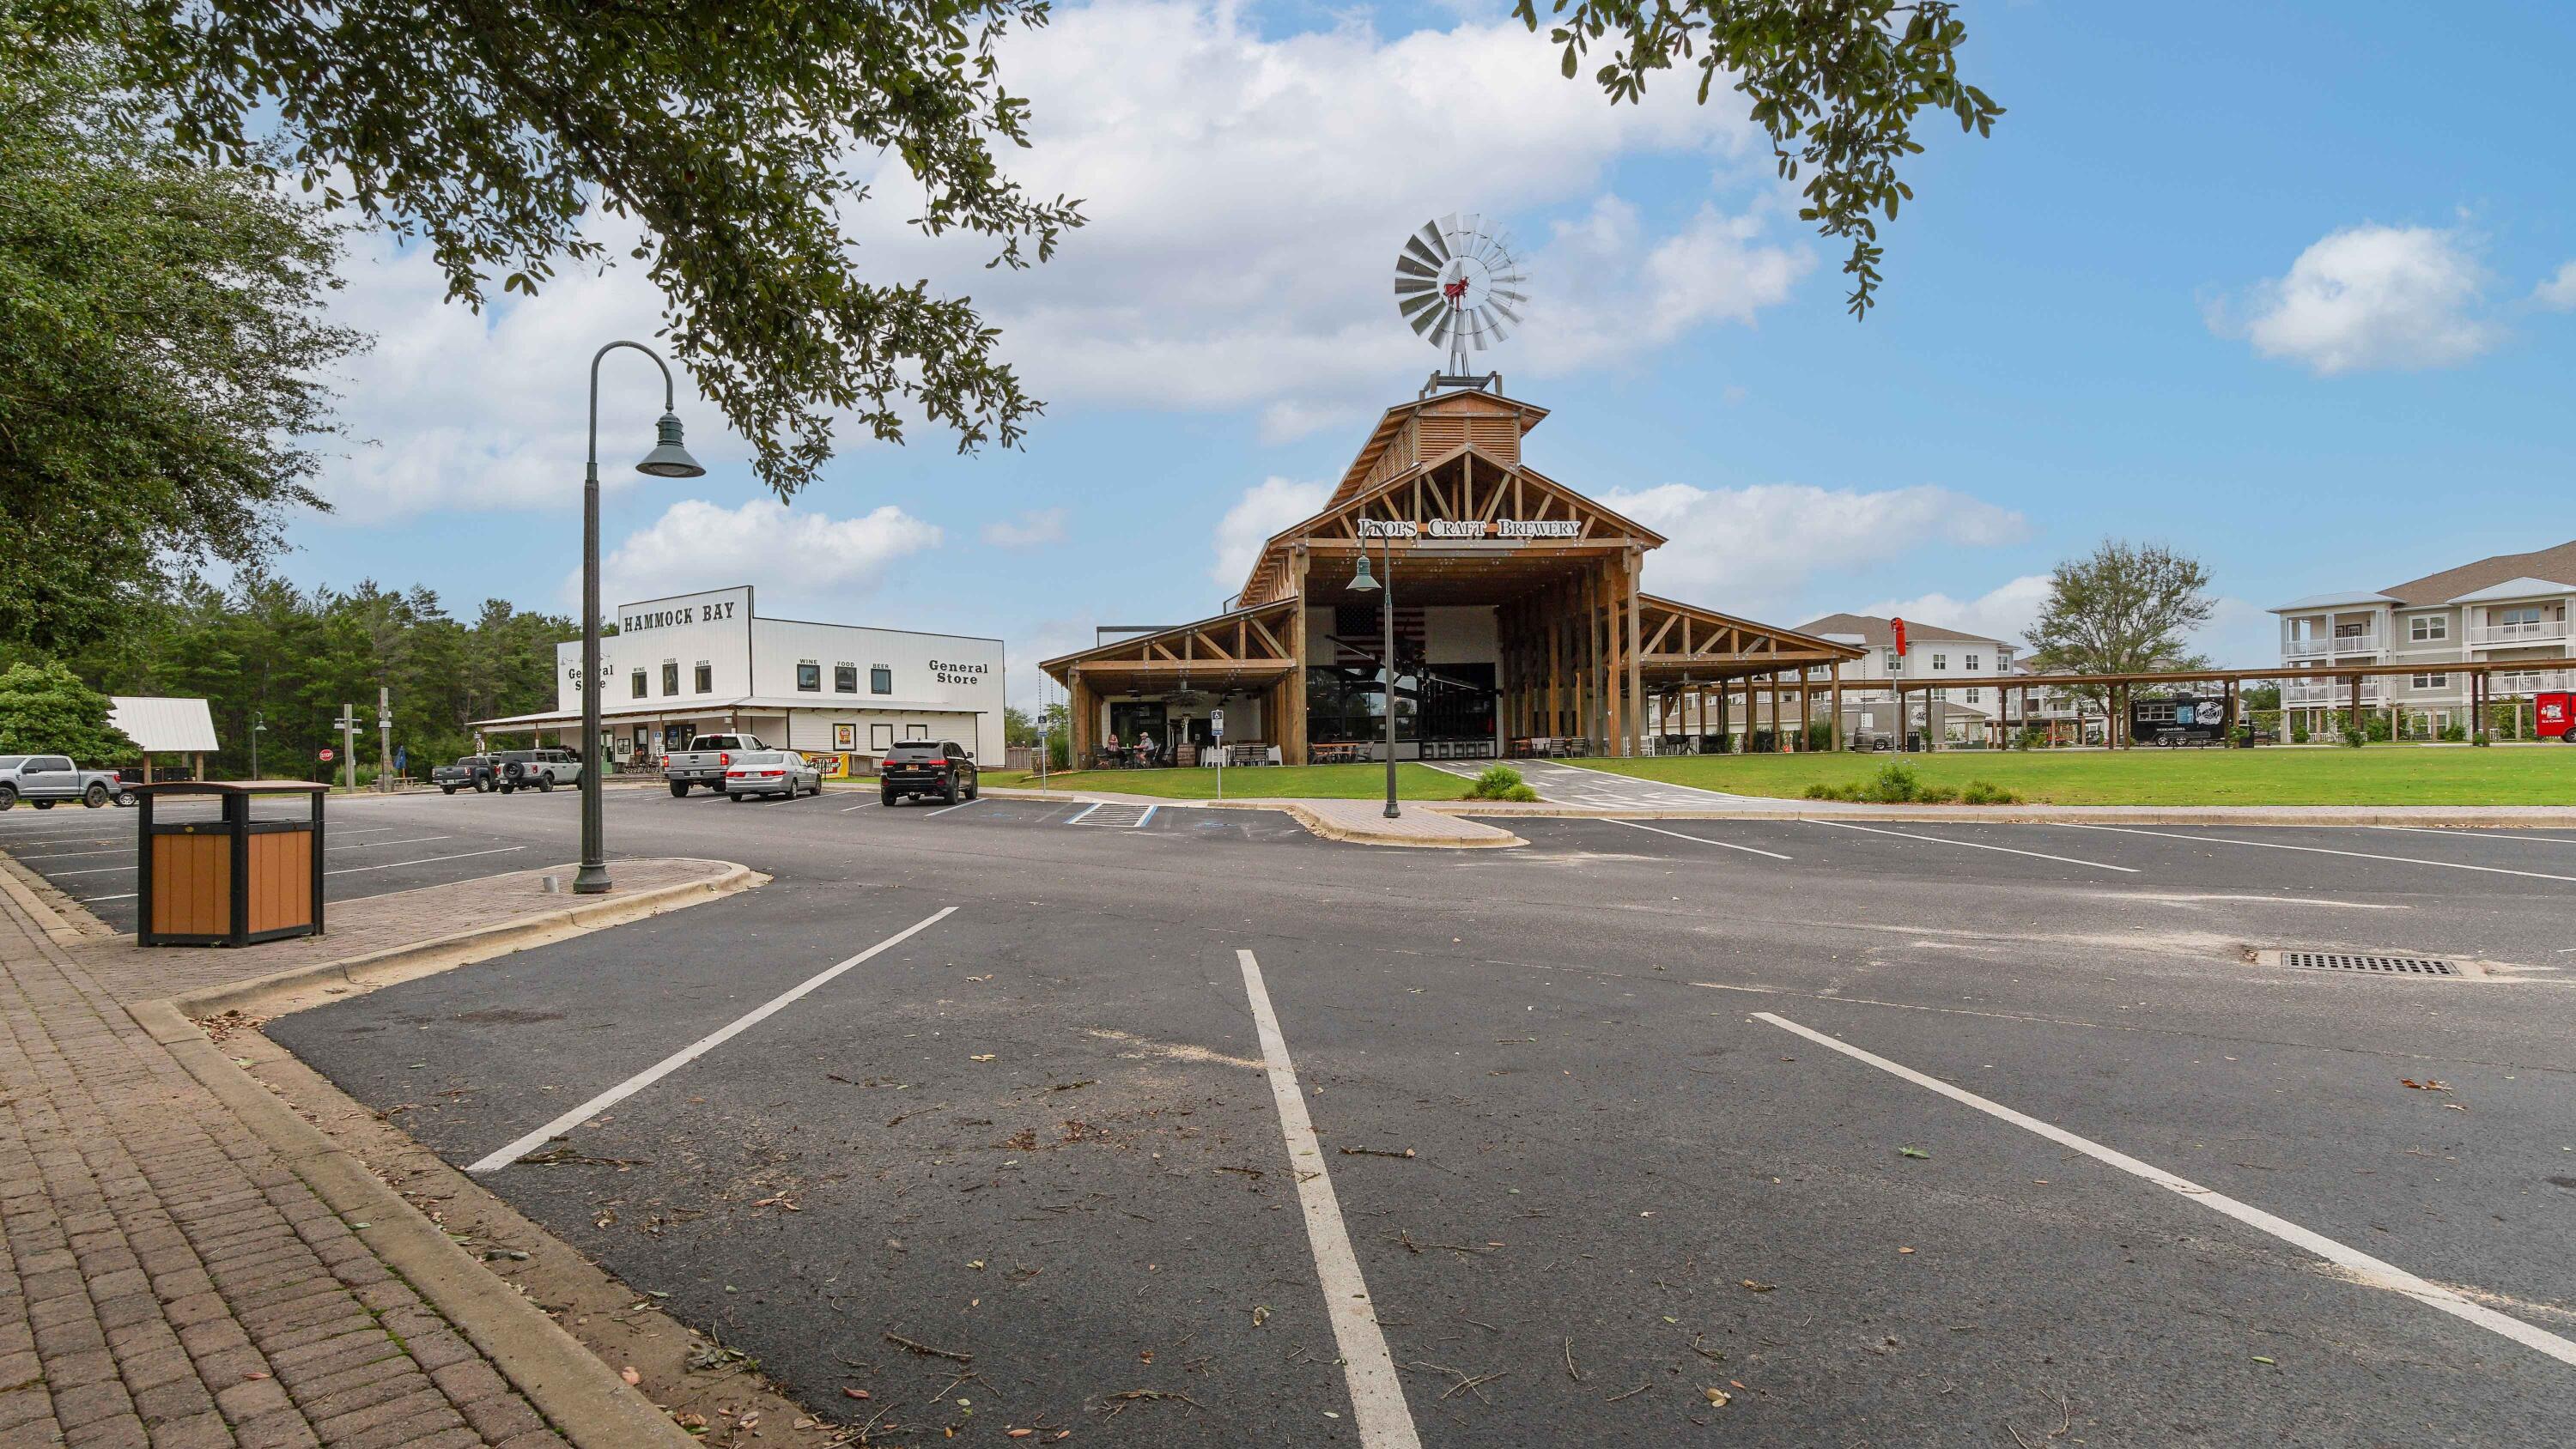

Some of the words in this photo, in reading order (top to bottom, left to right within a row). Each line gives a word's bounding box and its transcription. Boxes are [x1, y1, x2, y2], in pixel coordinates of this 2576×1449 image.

[1429, 519, 1486, 537] CRAFT
[1498, 519, 1580, 537] BREWERY
[624, 608, 693, 632] HAMMOCK
[702, 602, 734, 621] BAY
[568, 664, 613, 679] Geal
[929, 660, 988, 674] General
[937, 672, 978, 684] Store
